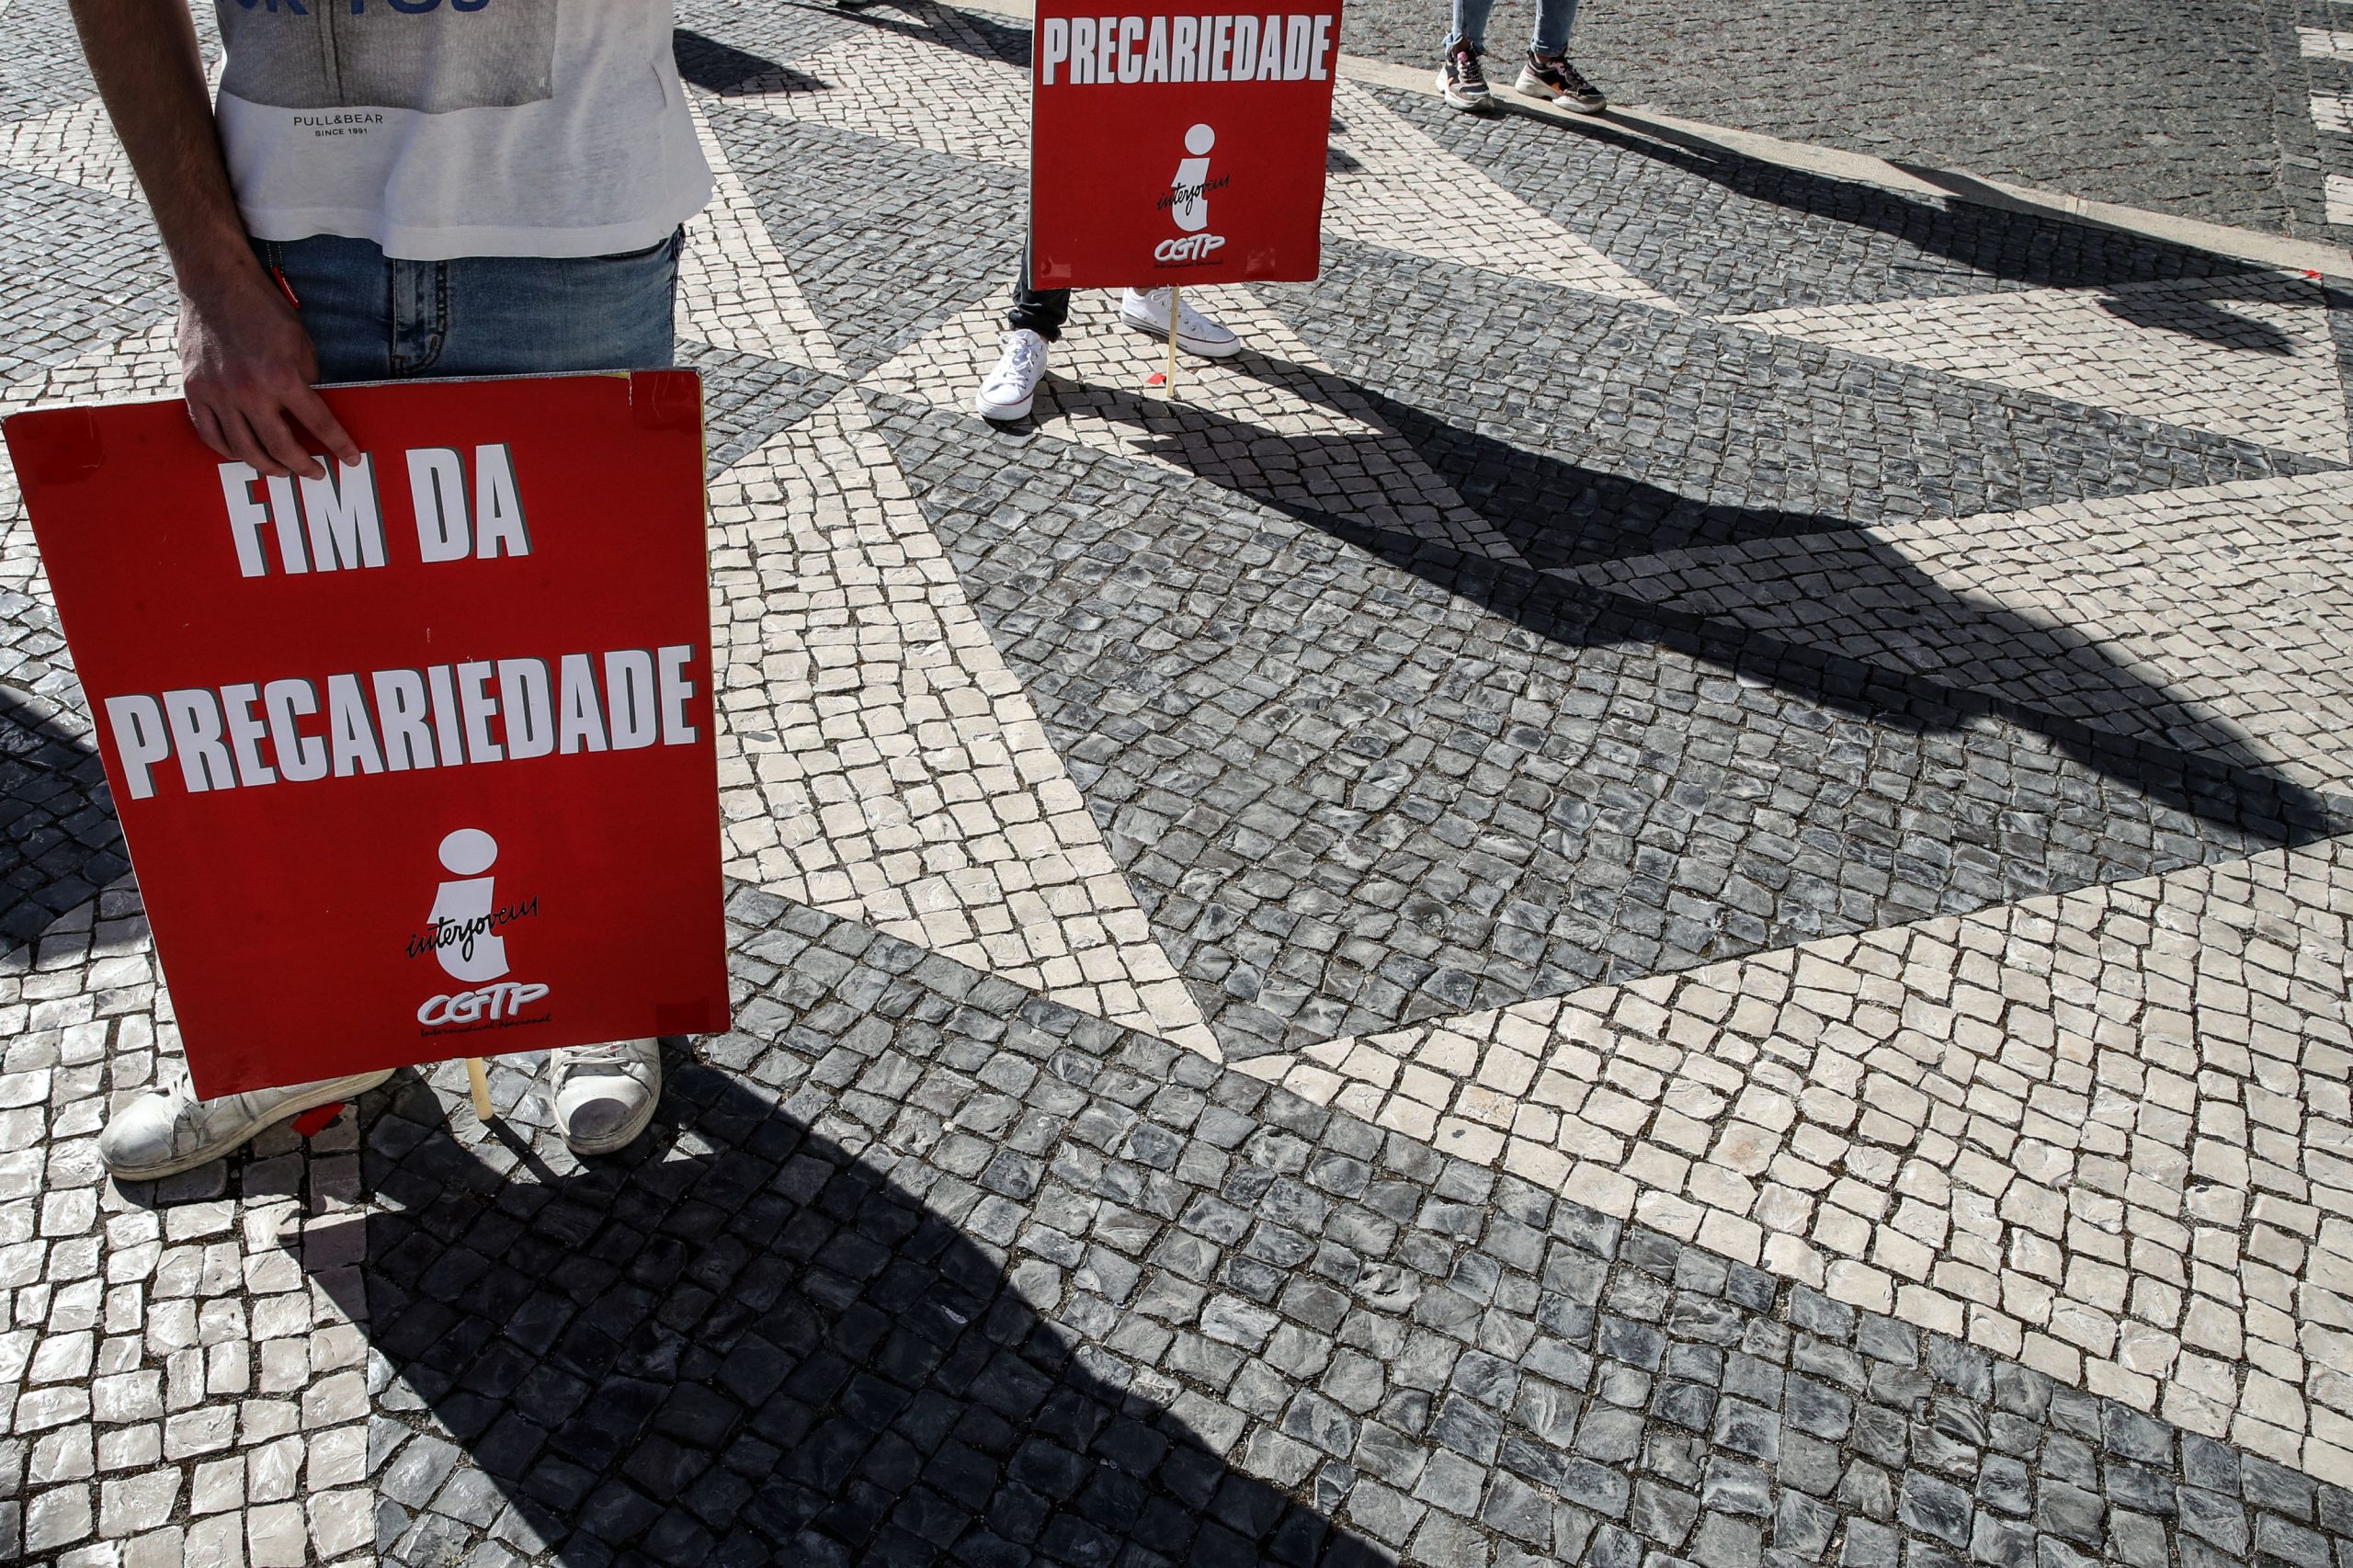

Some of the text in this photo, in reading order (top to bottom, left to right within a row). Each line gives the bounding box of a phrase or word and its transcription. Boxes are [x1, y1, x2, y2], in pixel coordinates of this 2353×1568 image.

[1042, 15, 1333, 85] PRECARIEDADE
[293, 114, 383, 127] PULL&BEAR
[314, 129, 345, 137] SINCE
[1154, 233, 1225, 262] CGTP
[218, 442, 533, 578] FIM DA
[105, 645, 699, 800] PRECARIEDADE
[417, 982, 550, 1026] CGTP
